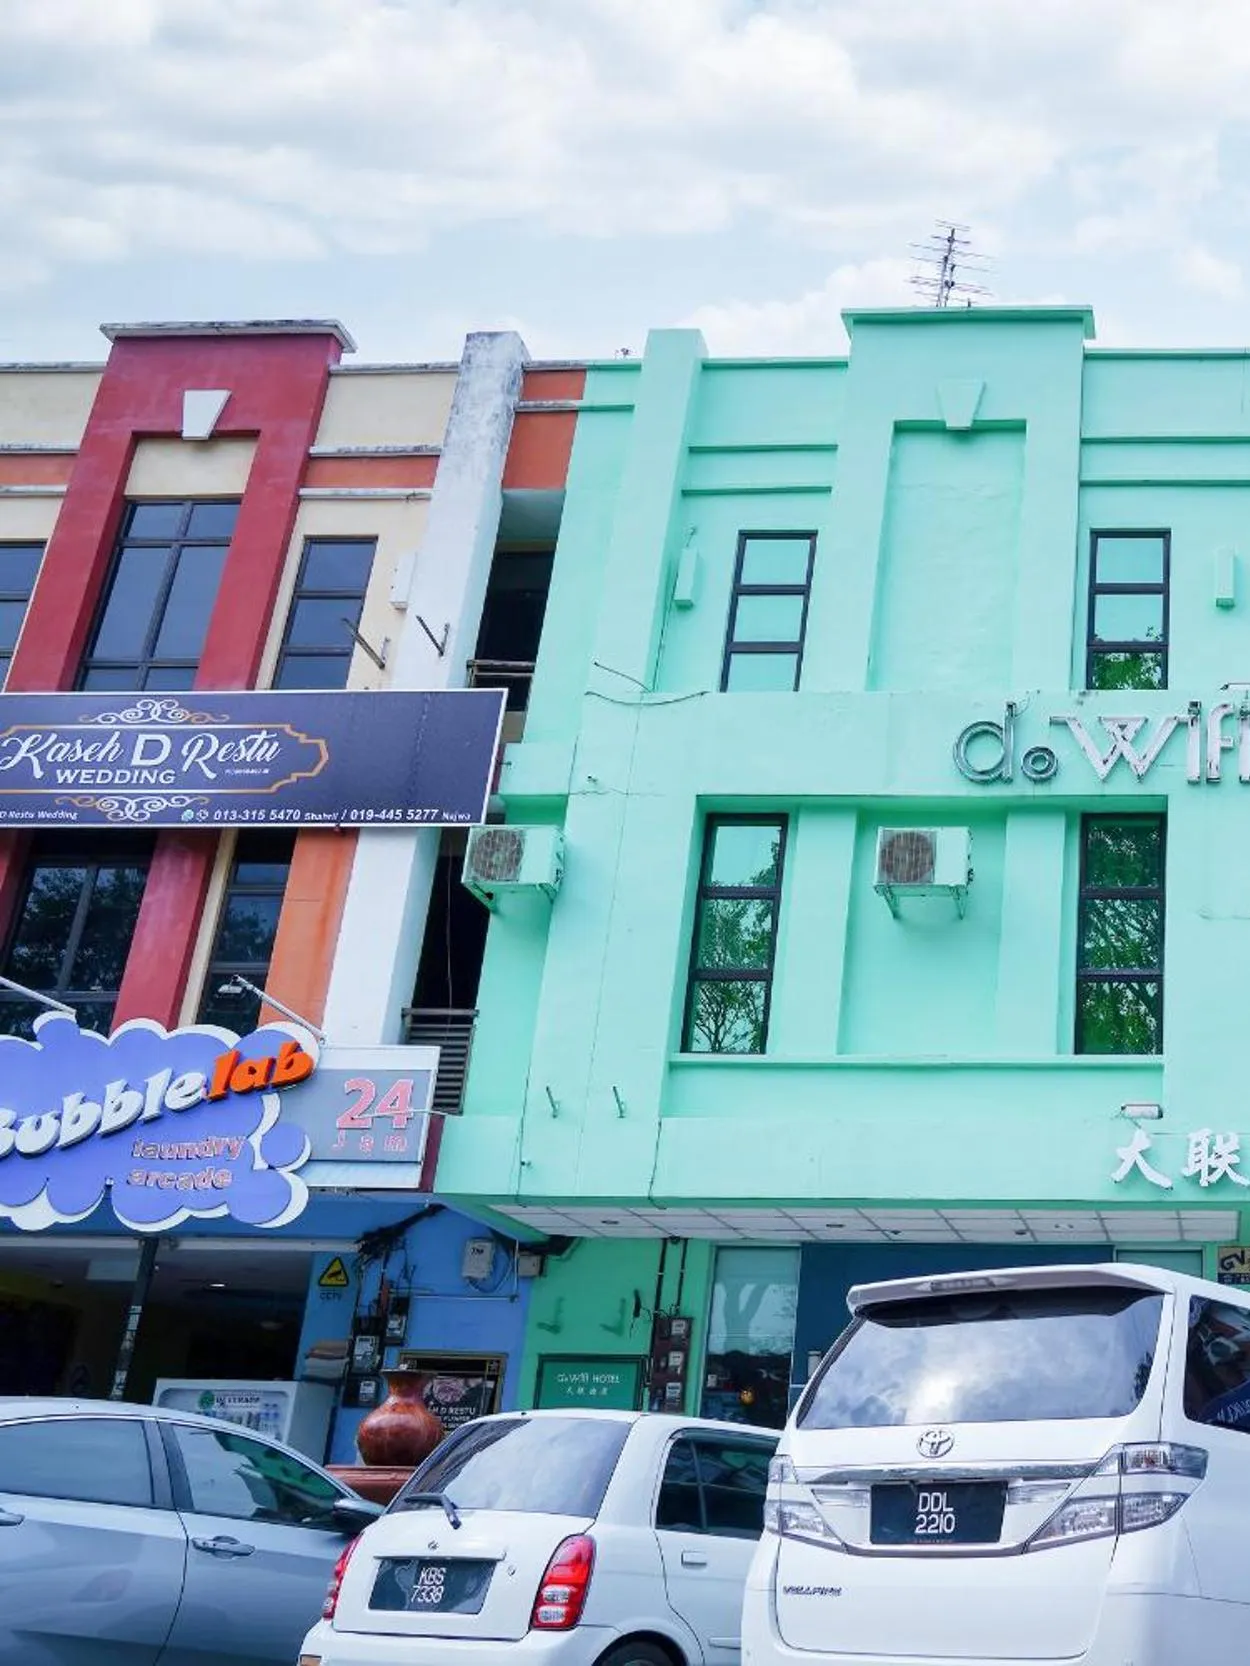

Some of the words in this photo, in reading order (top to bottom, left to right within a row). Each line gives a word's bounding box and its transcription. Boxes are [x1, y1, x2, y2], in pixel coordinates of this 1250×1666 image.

[0, 731, 124, 779] Kaseh
[130, 734, 172, 766] D
[181, 730, 281, 779] Restu
[56, 768, 176, 785] WEDDING
[37, 810, 78, 821] Wedding
[213, 809, 265, 821] 013-315
[269, 809, 301, 821] 5470
[350, 809, 402, 821] 019-445
[406, 809, 438, 821] 5277
[336, 1077, 414, 1129] 24
[131, 1136, 246, 1161] laundry
[126, 1166, 233, 1190] arcade
[918, 1491, 954, 1512] DDL
[914, 1513, 956, 1534] 2210
[418, 1567, 448, 1586] KBS
[410, 1585, 445, 1604] 7338
